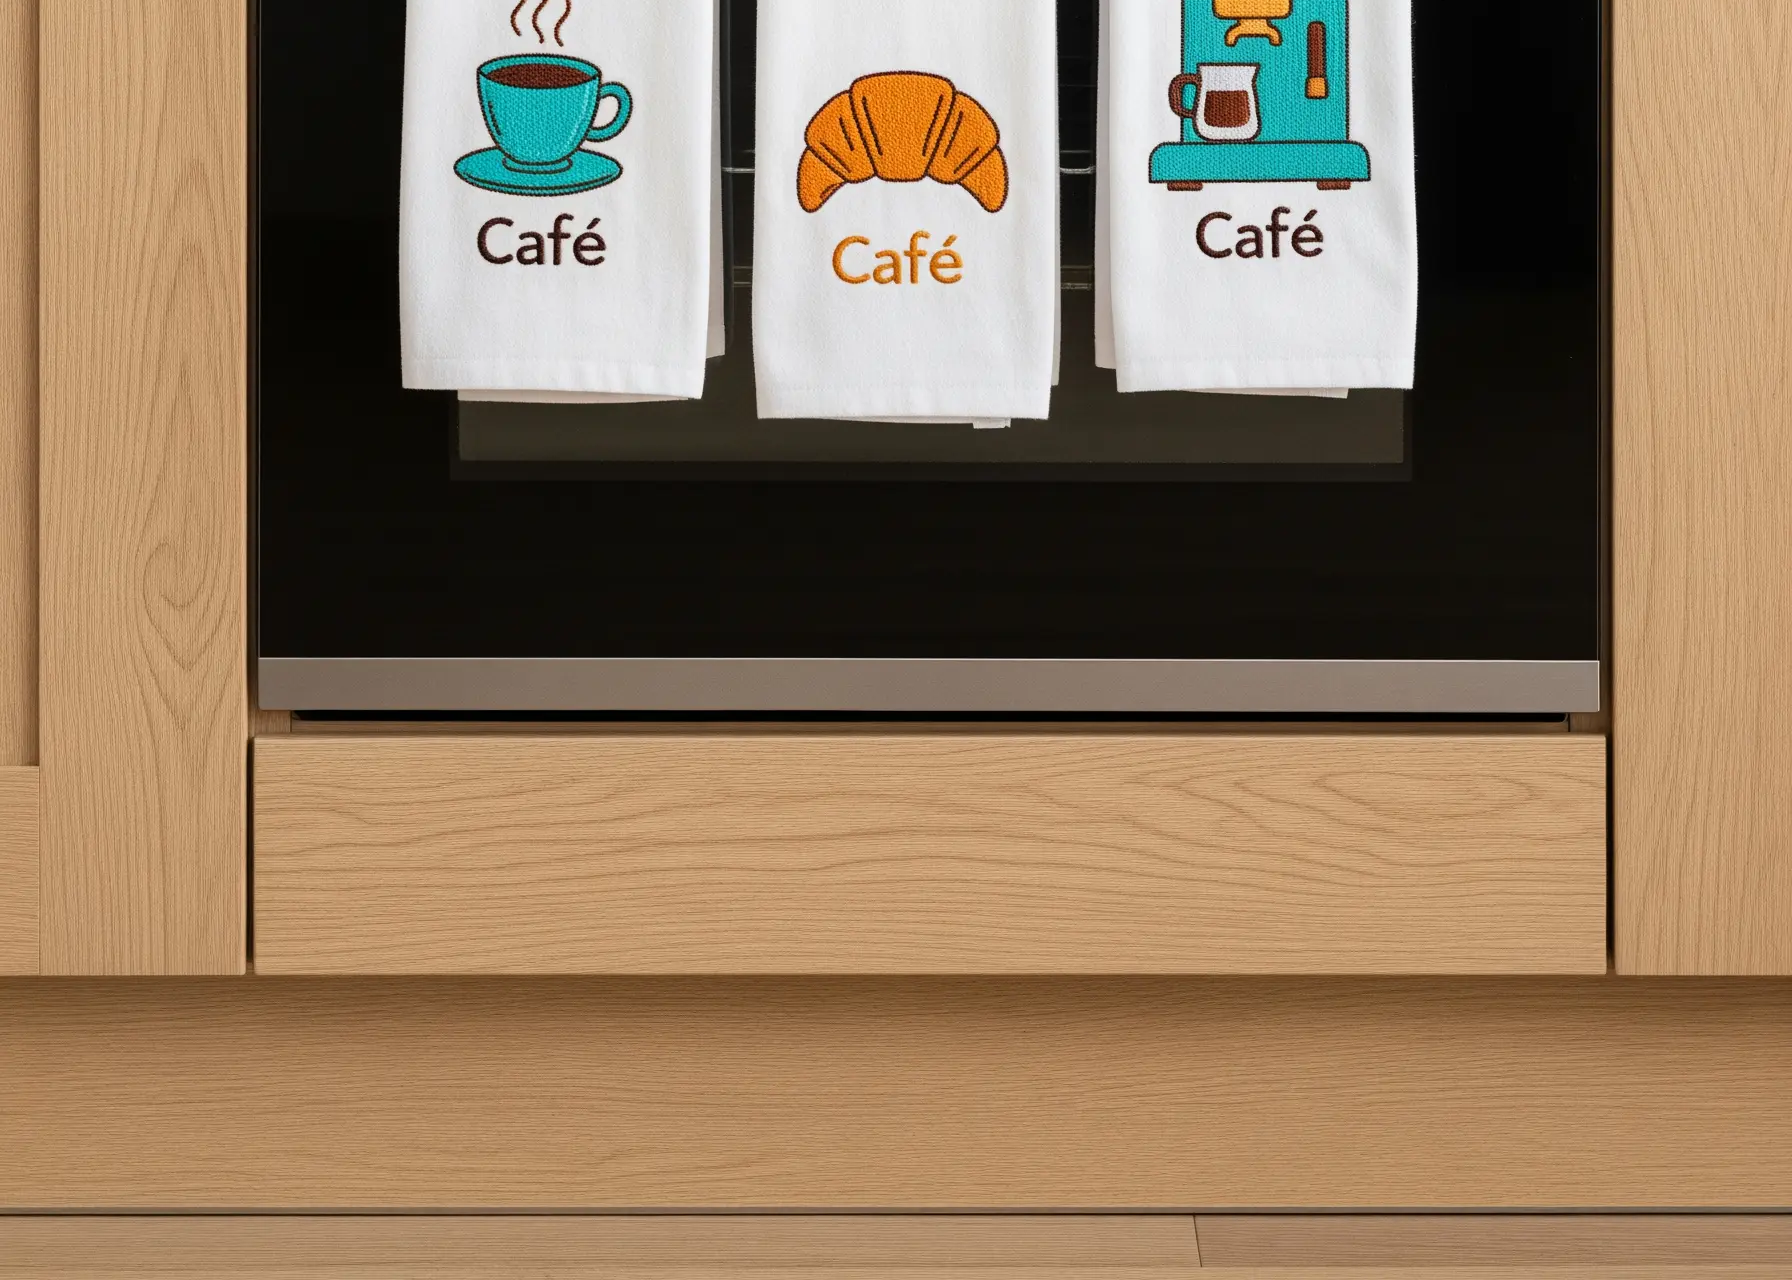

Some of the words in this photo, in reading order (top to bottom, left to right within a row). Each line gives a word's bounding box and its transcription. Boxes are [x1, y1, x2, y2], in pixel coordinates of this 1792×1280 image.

[477, 213, 606, 266] Café
[832, 230, 963, 284] Café
[1196, 206, 1323, 259] Café
